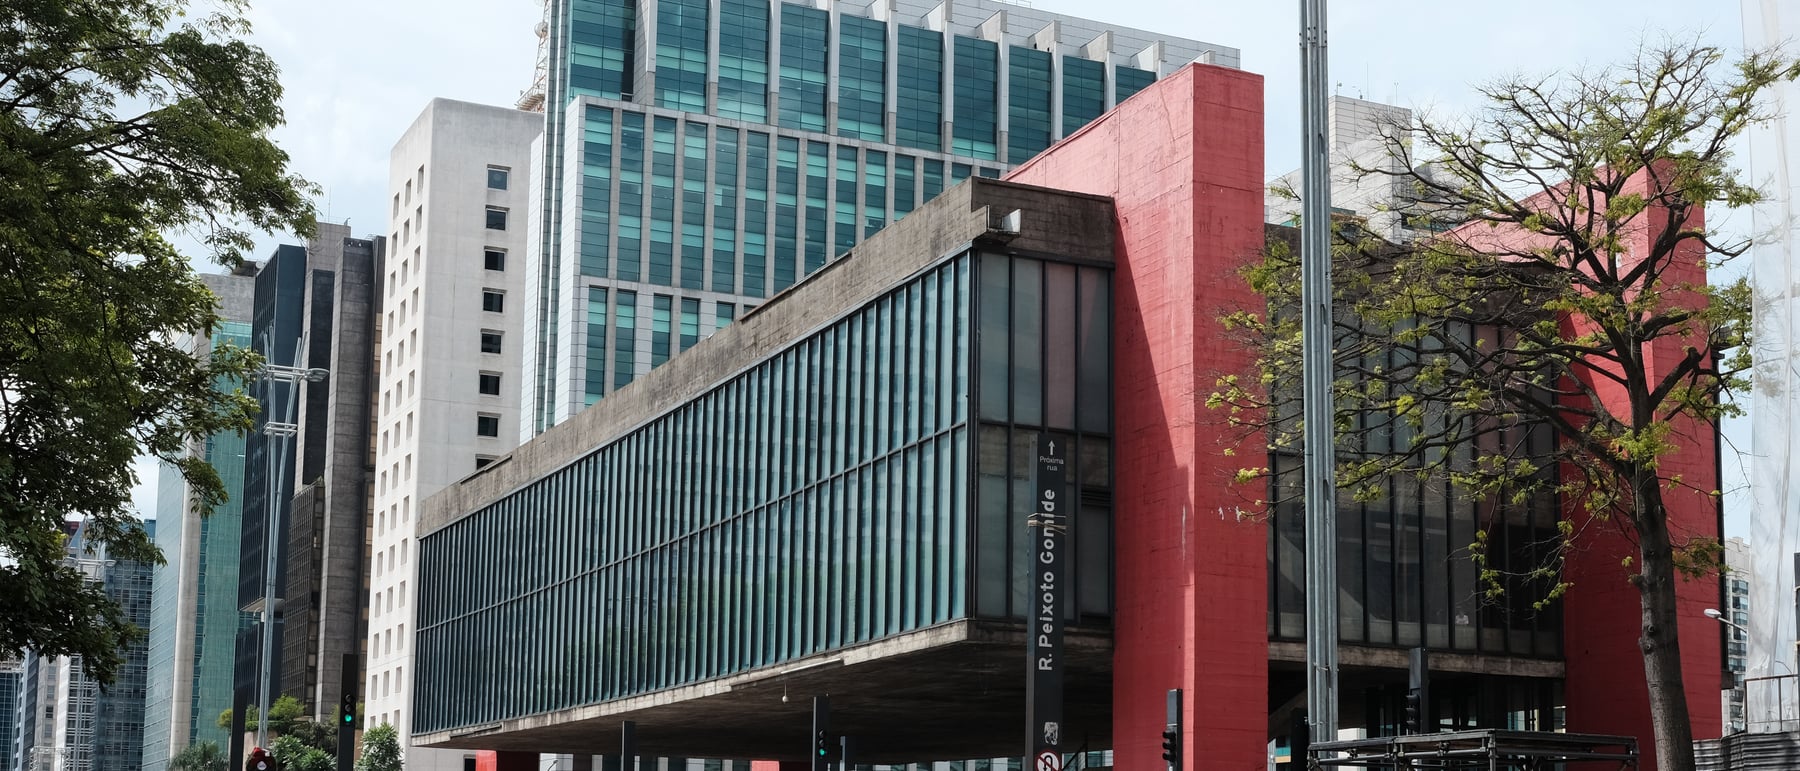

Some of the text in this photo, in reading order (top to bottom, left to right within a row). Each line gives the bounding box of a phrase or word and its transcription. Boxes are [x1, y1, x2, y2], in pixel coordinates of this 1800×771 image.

[1038, 489, 1055, 671] R. Peixoto Gomide
